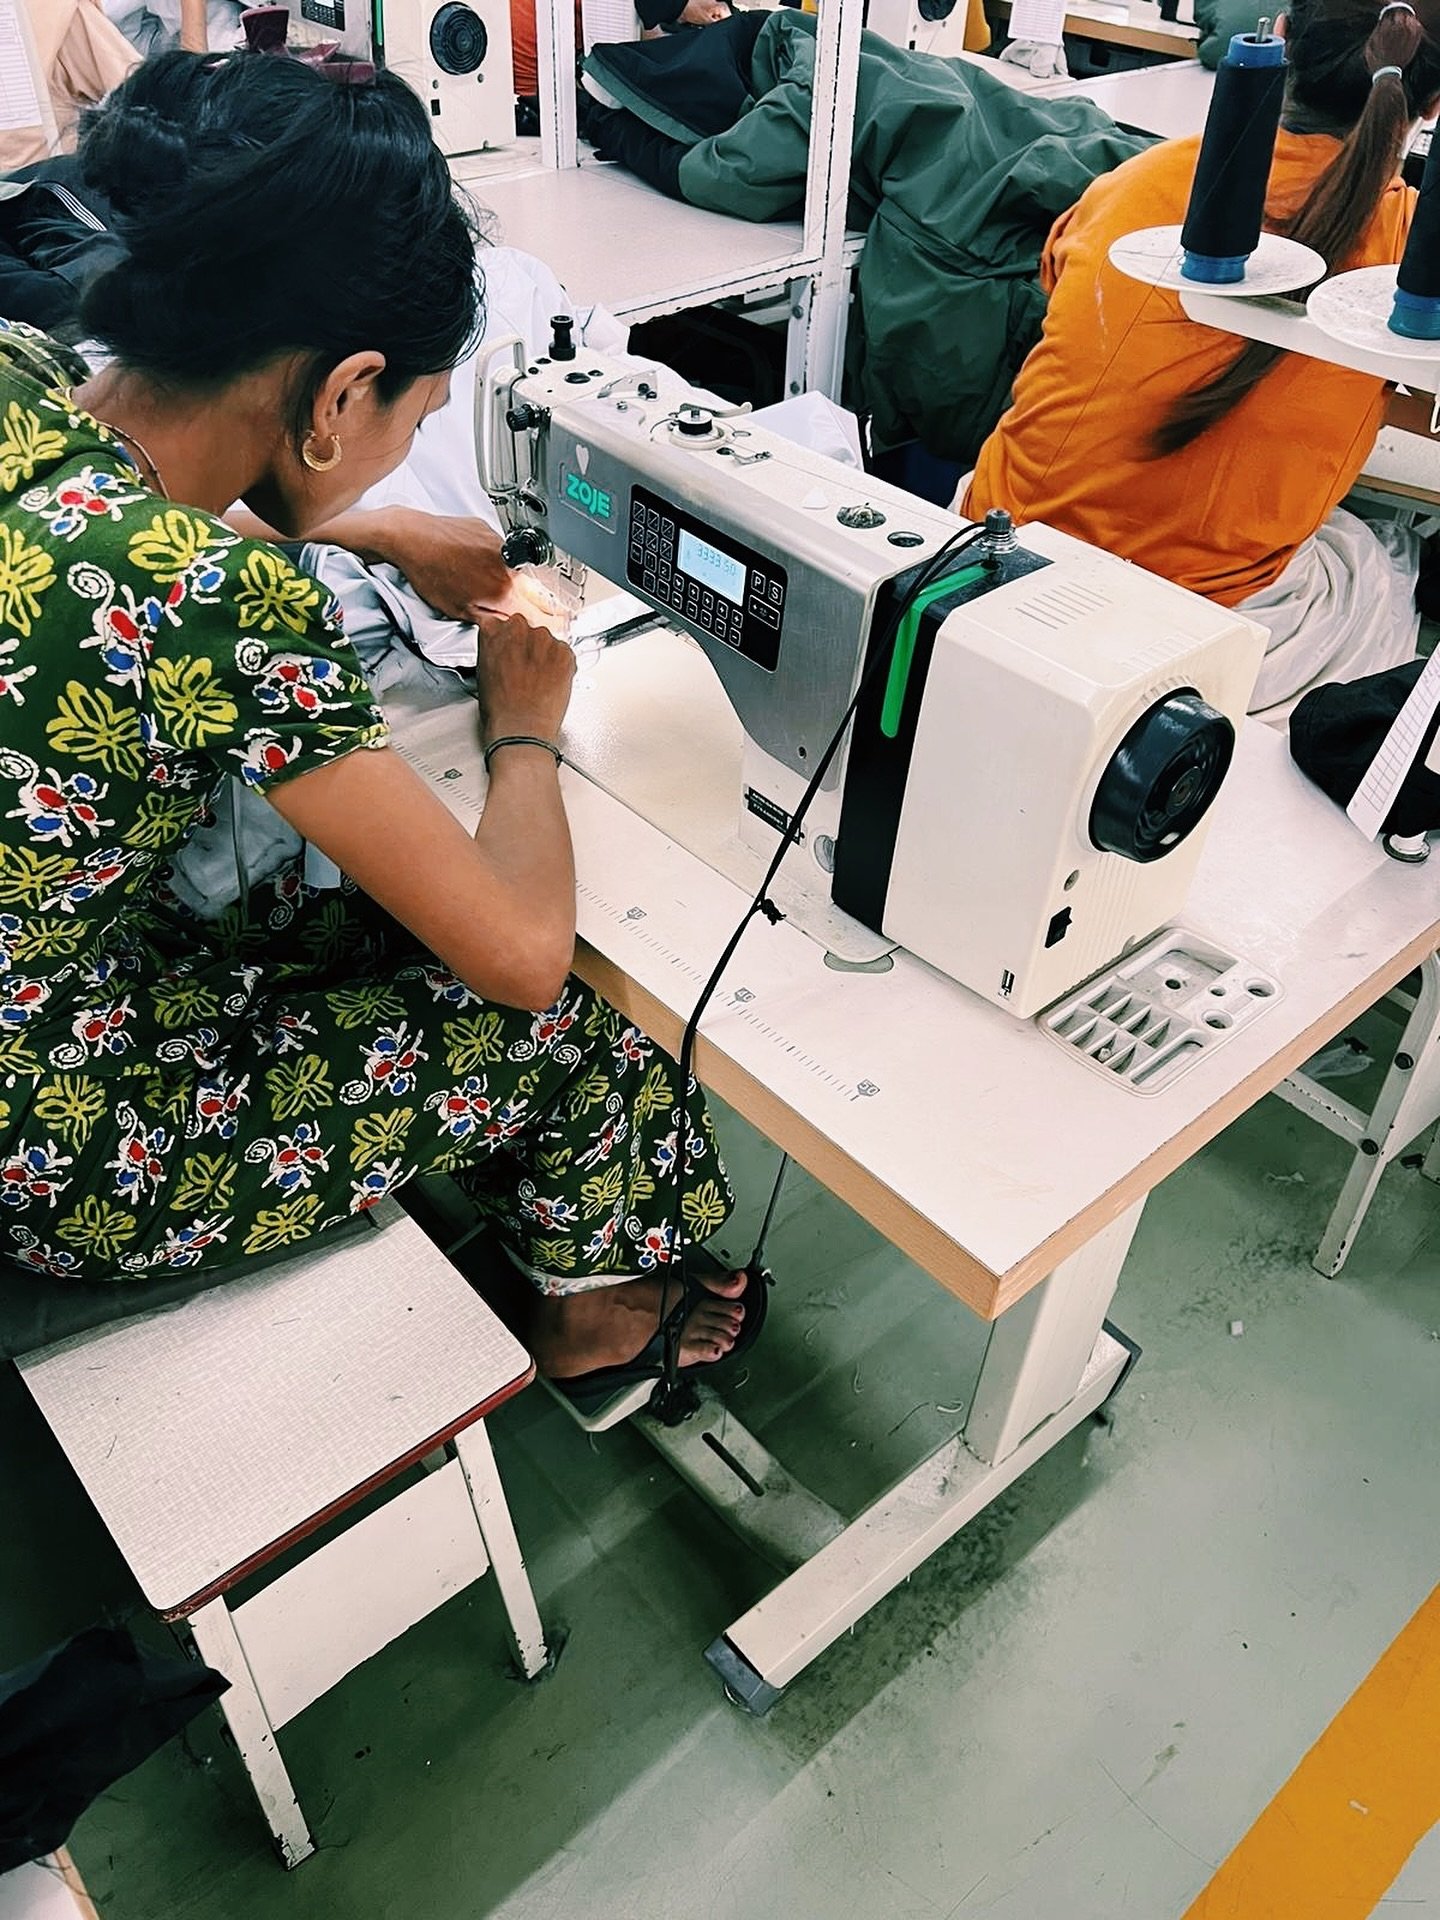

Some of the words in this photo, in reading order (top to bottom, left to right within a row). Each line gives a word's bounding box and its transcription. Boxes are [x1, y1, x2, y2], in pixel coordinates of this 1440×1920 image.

[567, 473, 610, 518] ZOJE
[754, 576, 762, 587] P
[771, 586, 780, 600] S
[858, 1080, 879, 1096] 50
